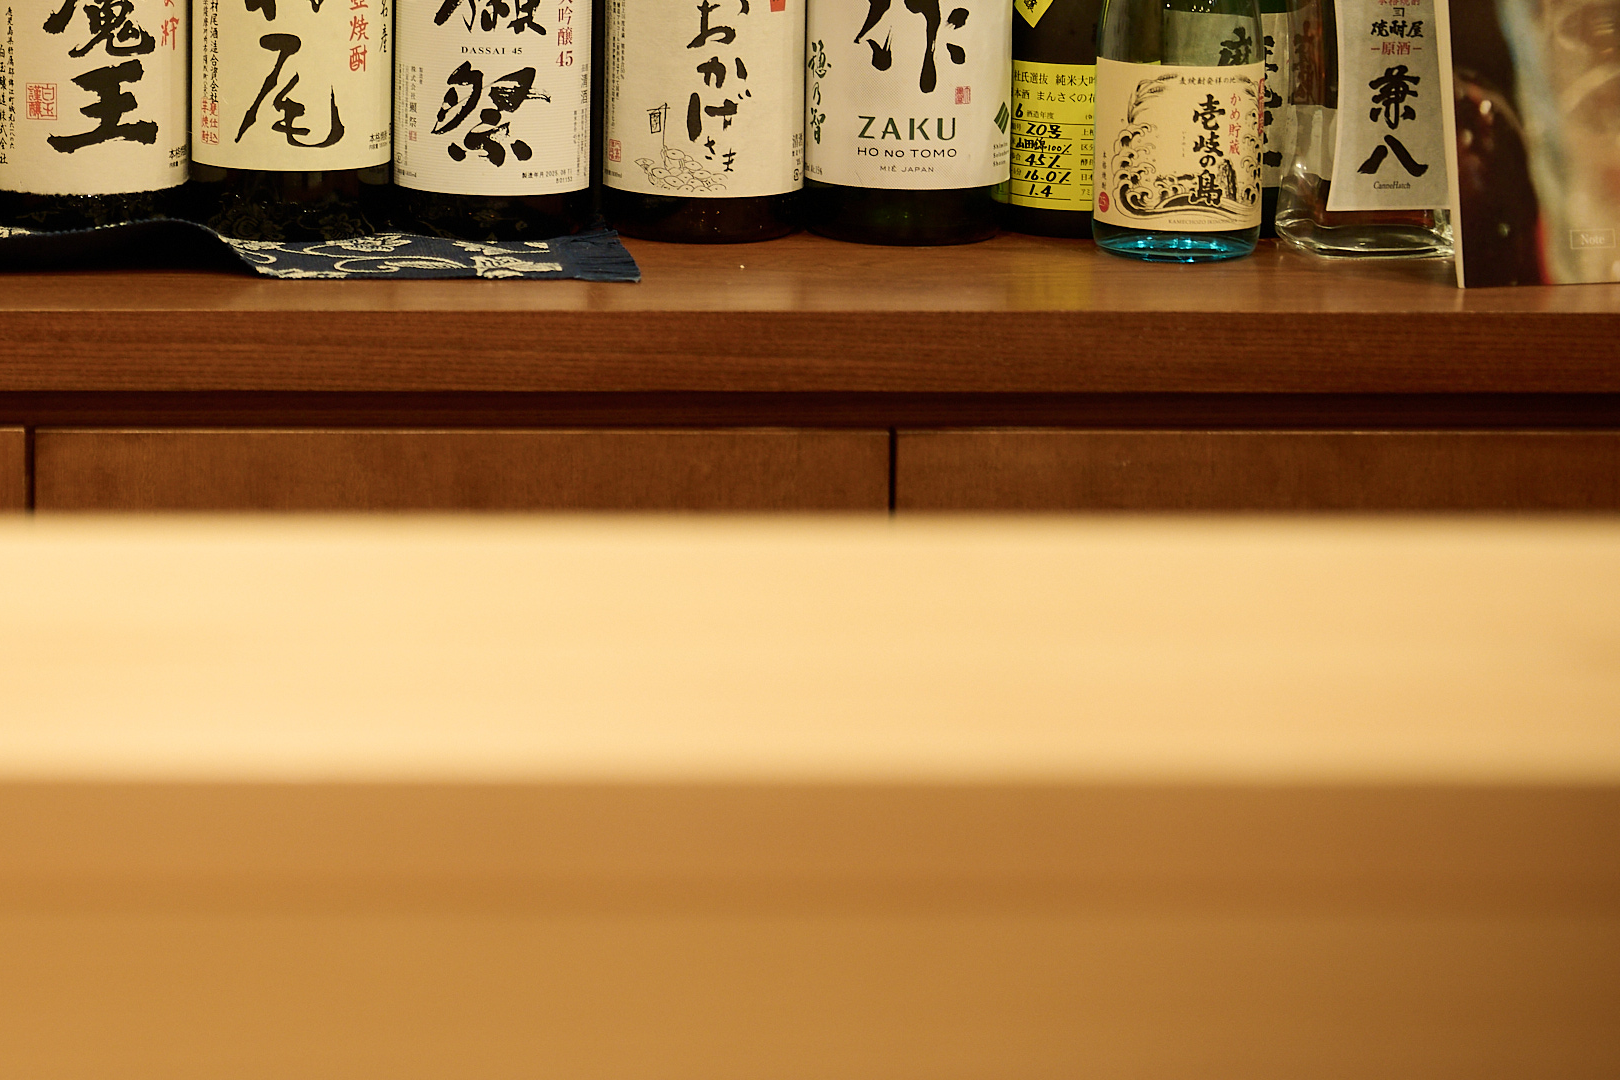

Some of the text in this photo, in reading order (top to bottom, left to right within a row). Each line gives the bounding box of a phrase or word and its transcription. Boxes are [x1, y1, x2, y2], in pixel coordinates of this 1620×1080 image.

[1370, 19, 1424, 39] 焼酎屋
[460, 46, 523, 55] DASSAI 45
[1014, 70, 1049, 85] 杜氏選抜
[858, 115, 956, 141] ZAKU
[1228, 92, 1242, 156] かめ貯蔵
[1356, 64, 1429, 178] 兼八
[857, 146, 957, 158] HO NO TOMO
[1190, 93, 1226, 206] 壱岐の島
[1024, 153, 1061, 168] 45%
[1024, 169, 1072, 184] 16.0%
[1029, 183, 1053, 198] 1.4
[1580, 233, 1605, 246] Note
